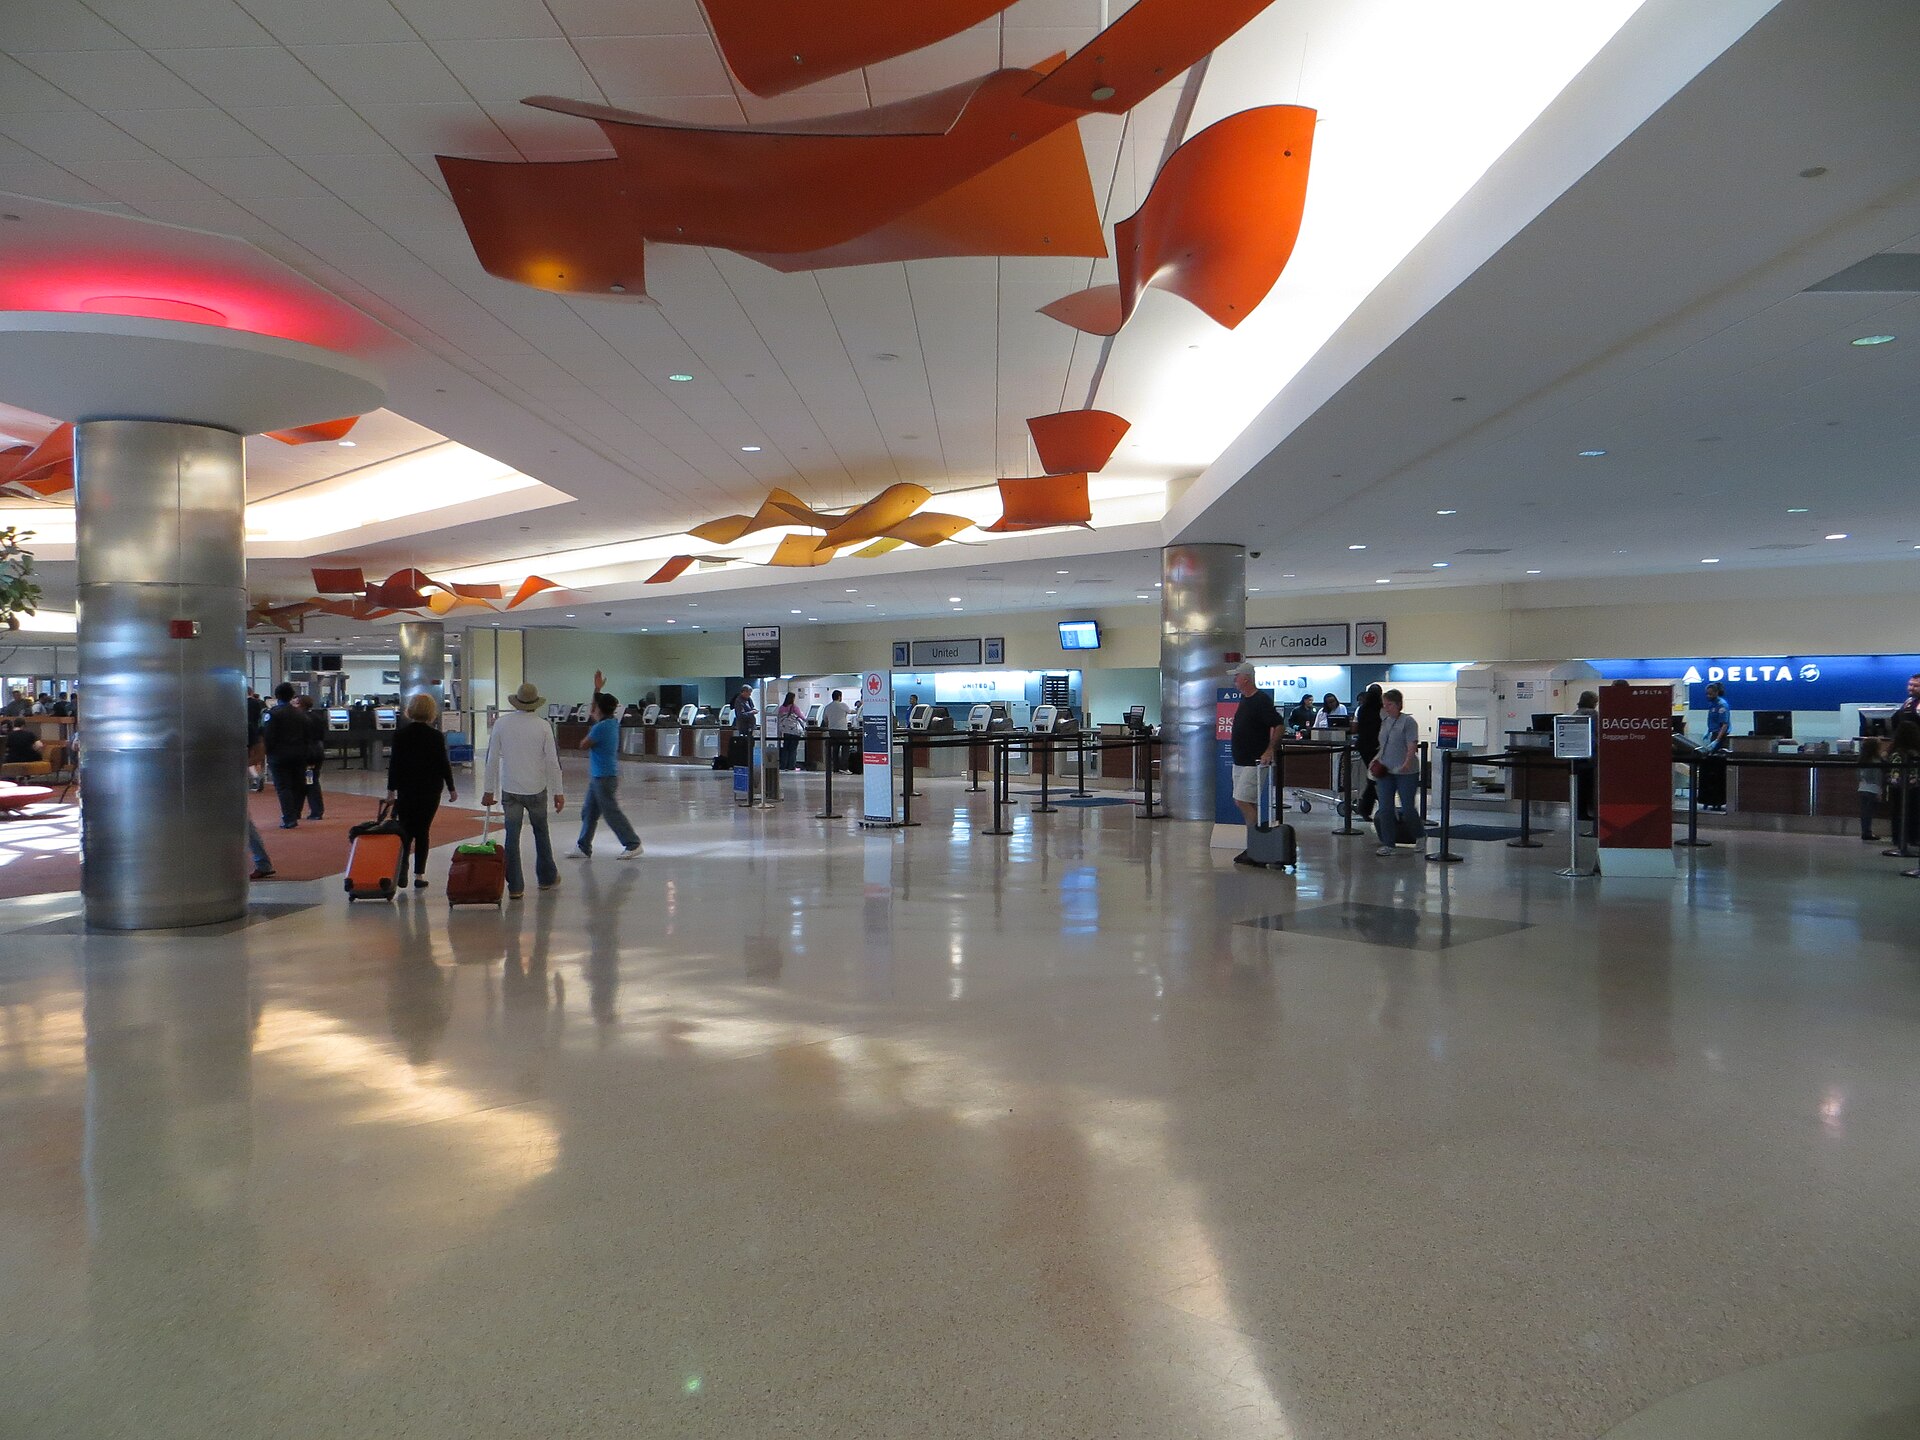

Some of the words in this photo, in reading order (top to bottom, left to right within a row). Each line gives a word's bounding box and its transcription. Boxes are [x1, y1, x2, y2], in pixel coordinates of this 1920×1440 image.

[1259, 635, 1276, 648] Air
[1280, 634, 1327, 648] Canada
[932, 647, 959, 658] United
[1708, 666, 1793, 682] DELTA
[1218, 717, 1234, 726] SK
[1602, 718, 1668, 730] BAGGAGE
[1602, 733, 1629, 741] Baggage
